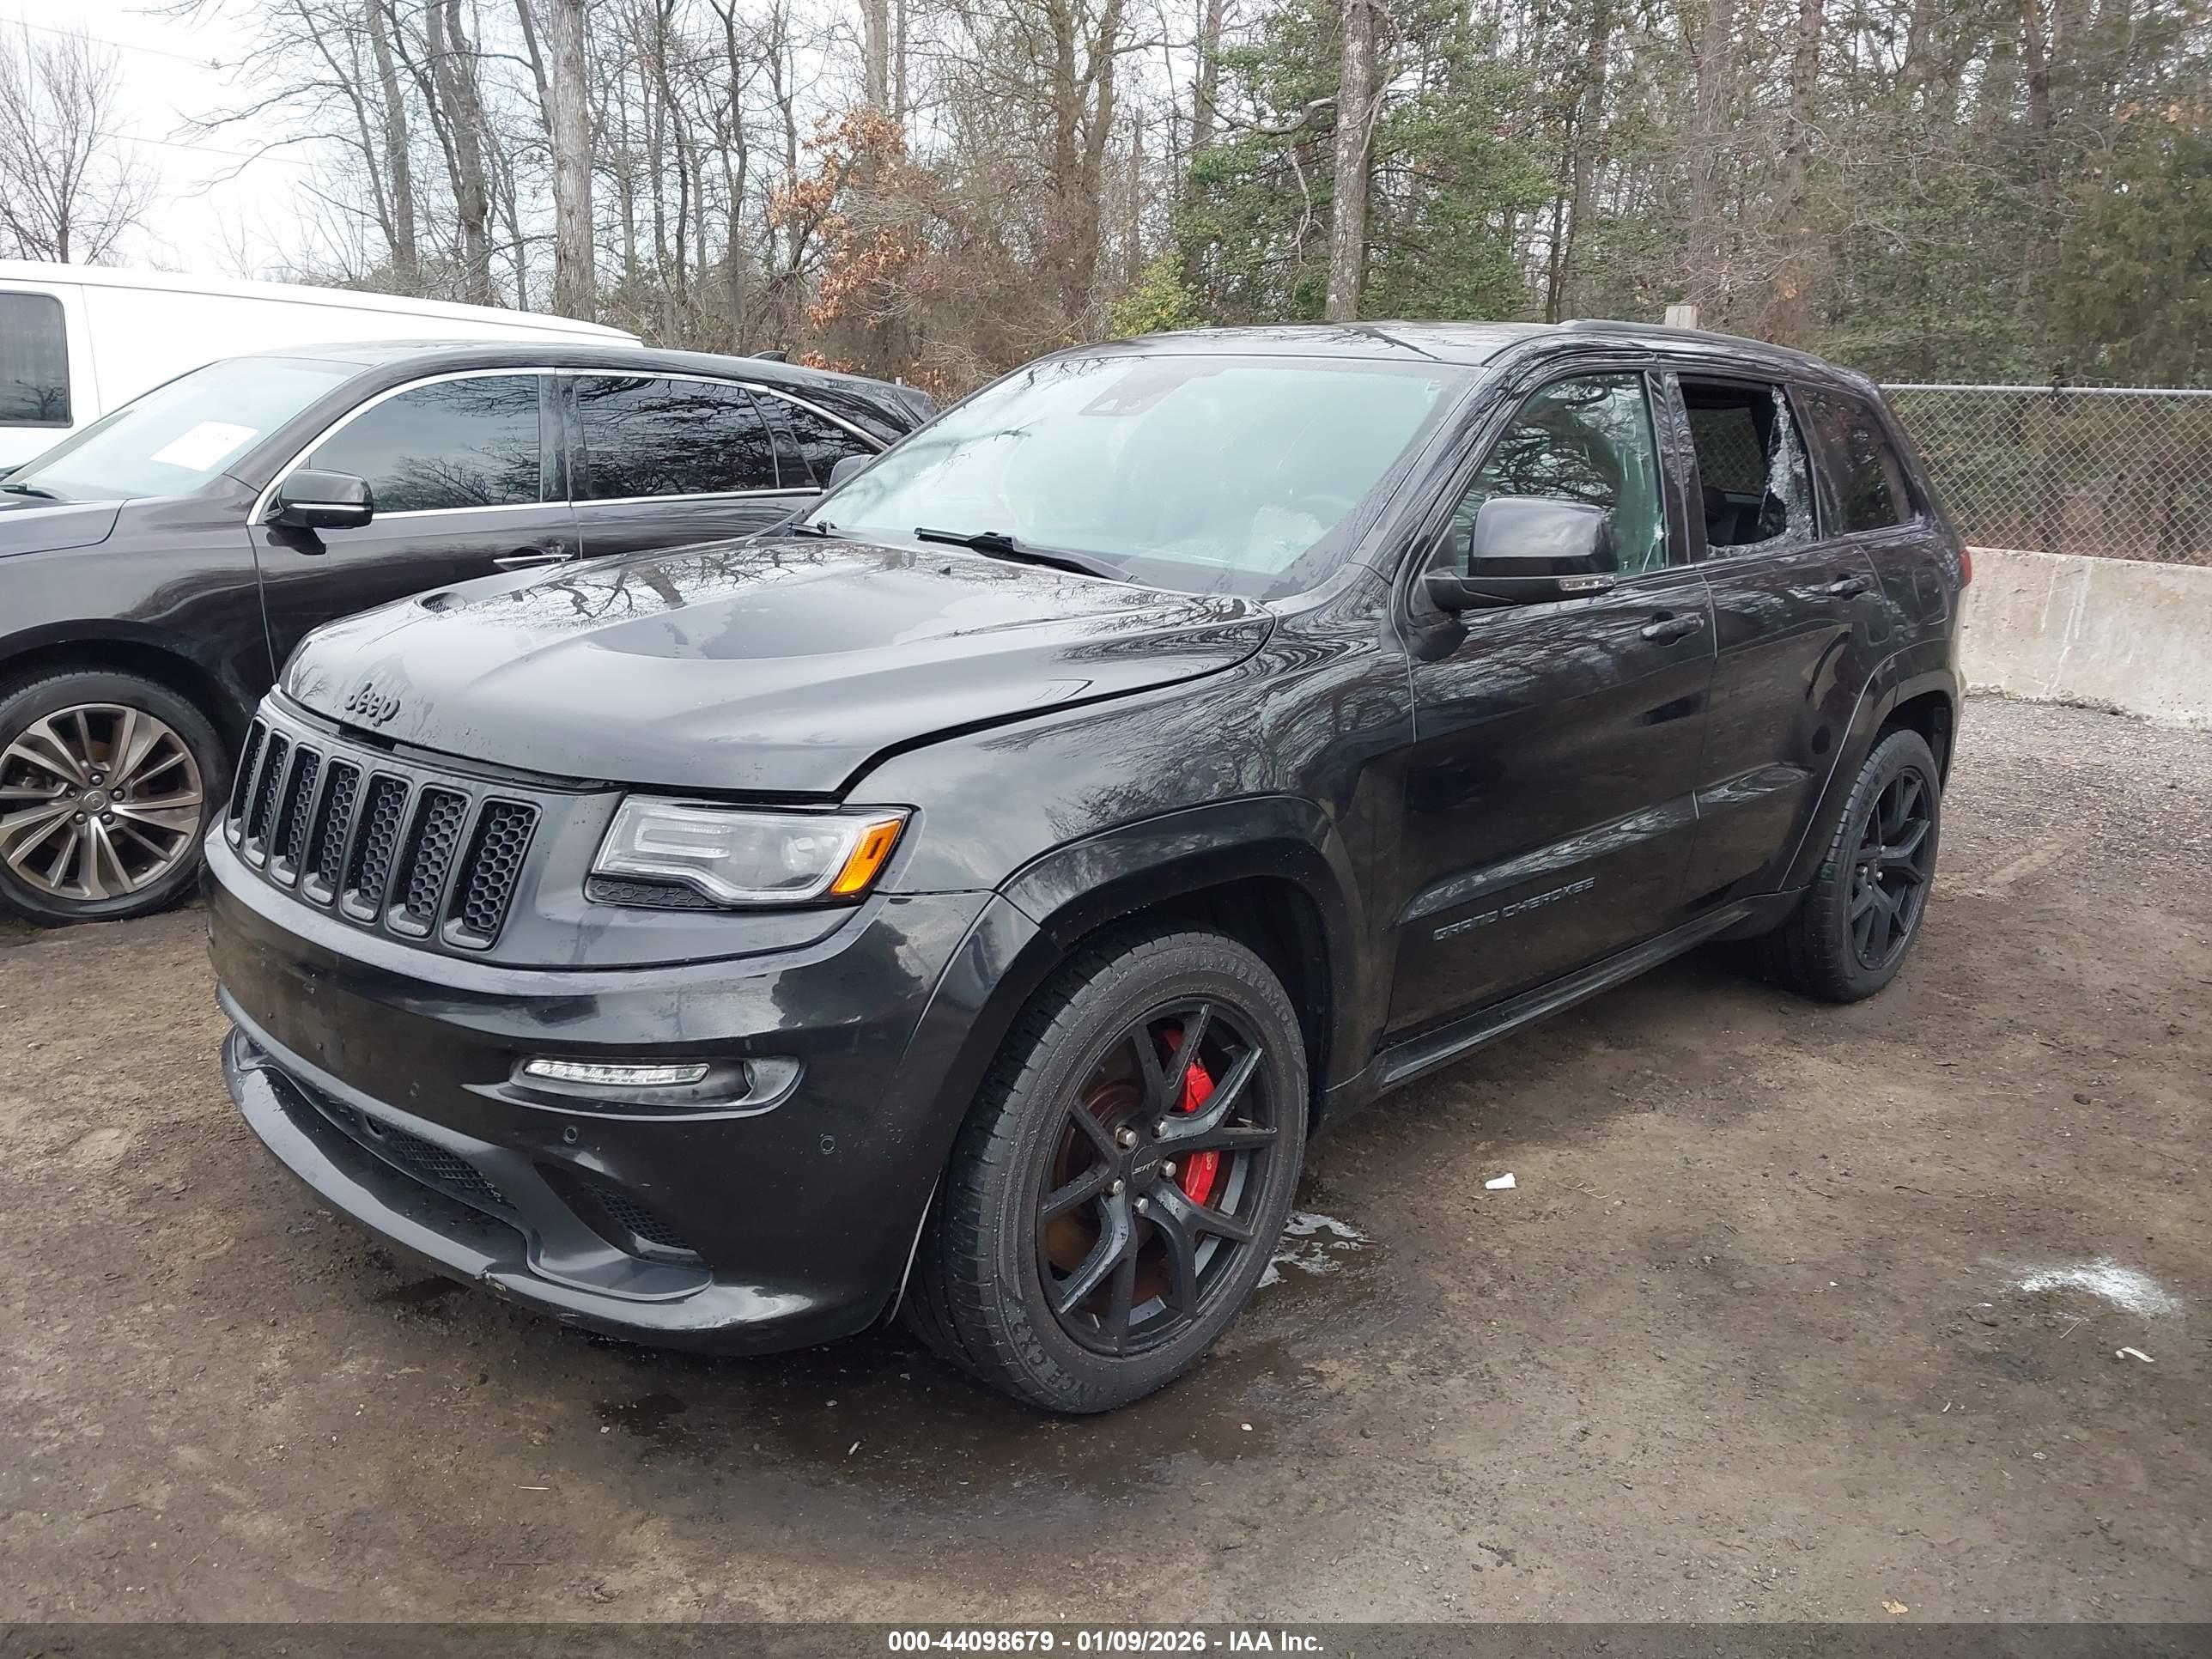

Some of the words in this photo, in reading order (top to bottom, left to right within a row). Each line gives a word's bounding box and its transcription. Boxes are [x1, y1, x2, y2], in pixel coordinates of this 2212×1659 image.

[343, 680, 401, 727] Jeep
[1432, 909, 1498, 941] GRAND
[1503, 876, 1596, 918] CHEROKEE
